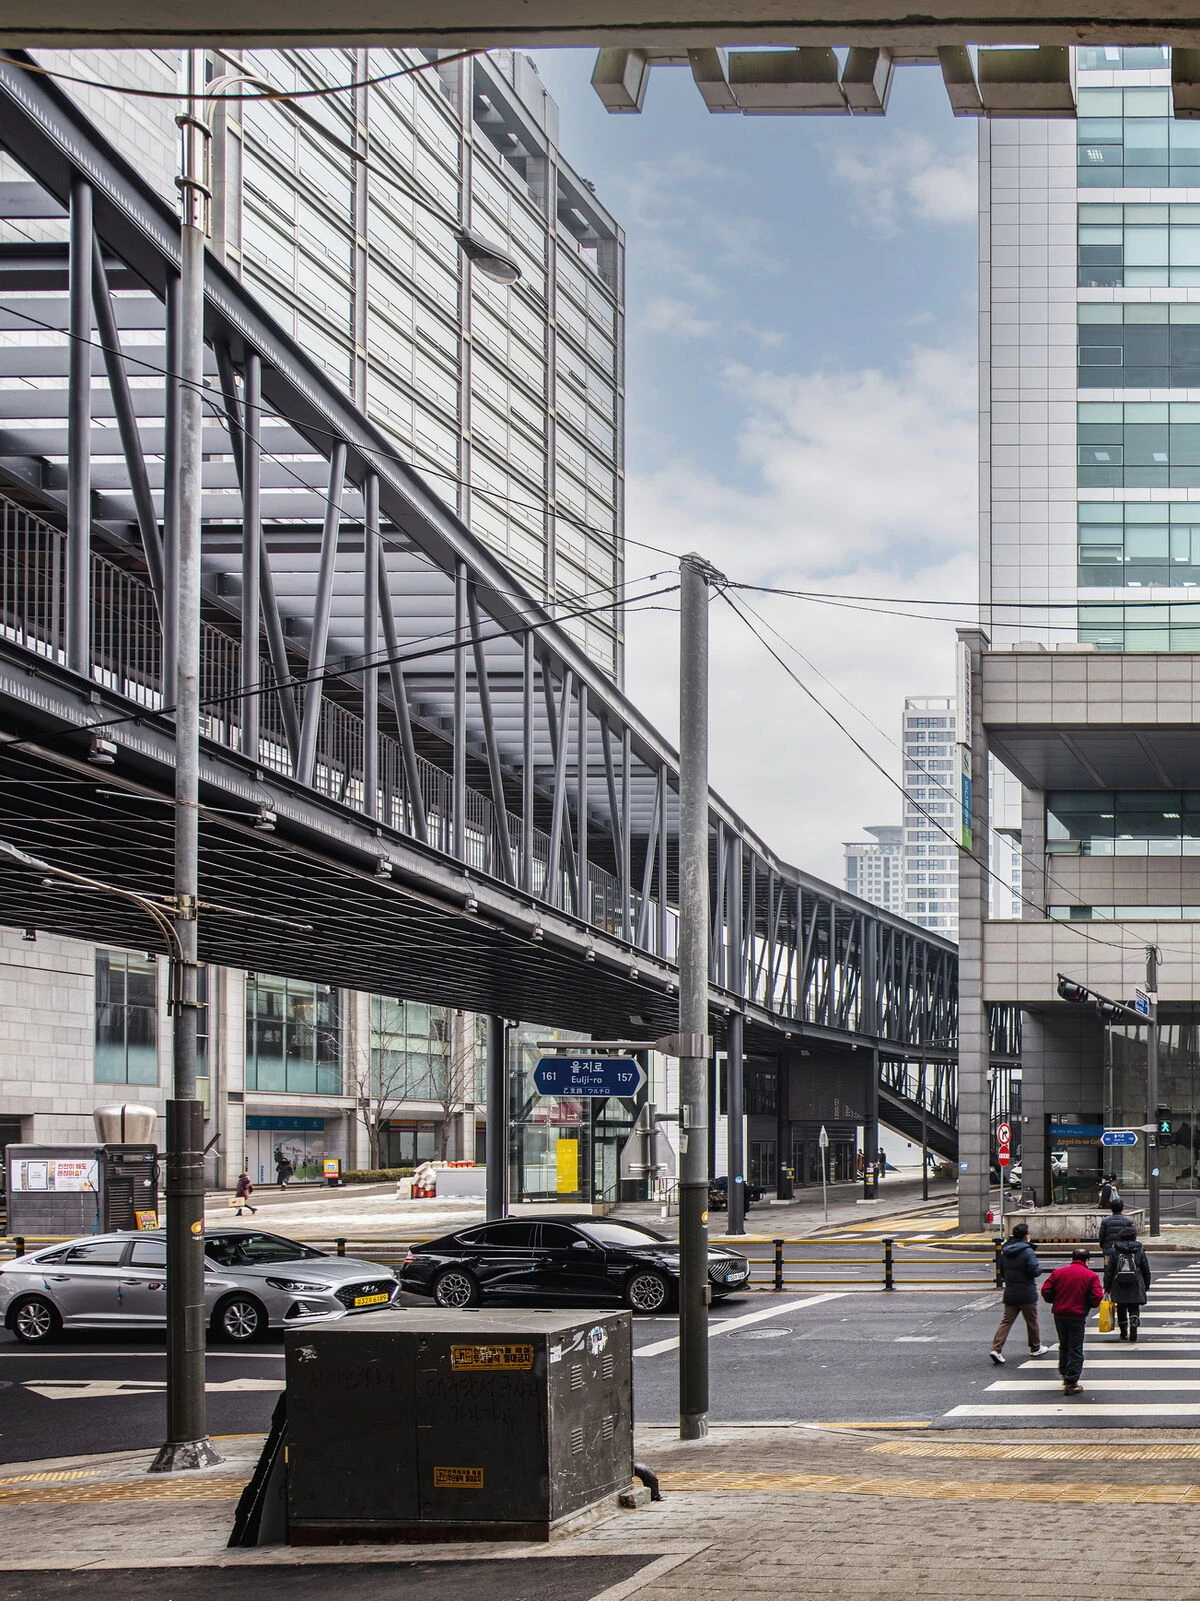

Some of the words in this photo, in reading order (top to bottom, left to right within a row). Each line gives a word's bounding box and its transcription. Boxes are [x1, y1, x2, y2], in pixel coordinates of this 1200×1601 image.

[570, 1060, 604, 1074] 을지로
[542, 1071, 557, 1081] 161
[571, 1075, 602, 1085] Eulji-ro
[617, 1073, 633, 1082] 157
